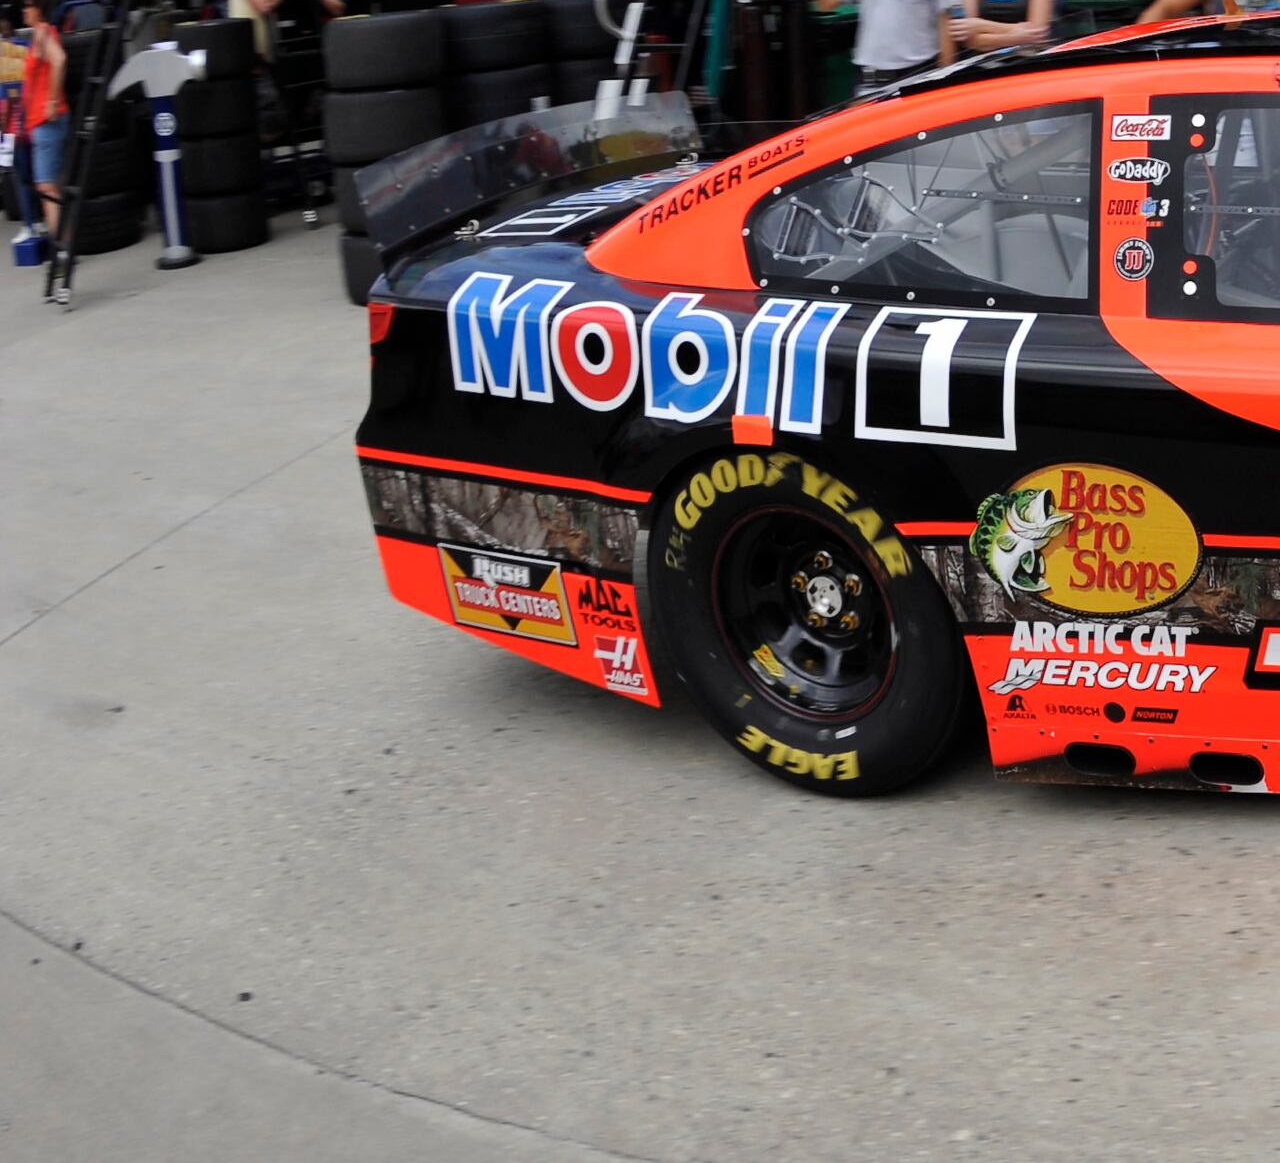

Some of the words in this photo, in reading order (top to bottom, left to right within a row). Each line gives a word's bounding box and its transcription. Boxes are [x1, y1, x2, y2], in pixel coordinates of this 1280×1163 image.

[637, 164, 743, 234] TRACKER
[748, 136, 805, 169] BOATS
[1107, 199, 1139, 216] CODE
[1158, 198, 1171, 218] 3
[447, 271, 852, 436] Mobil
[1058, 469, 1146, 515] Bass
[674, 451, 913, 579] GOODYEAR
[1064, 512, 1131, 551] Pro
[471, 555, 530, 587] RUSH
[1069, 550, 1177, 601] Shops
[454, 581, 498, 609] TRUCK
[500, 590, 562, 621] CENTERS
[578, 578, 634, 618] MAC
[582, 613, 637, 632] TOOLS
[1010, 621, 1129, 655] ARCTIC
[1131, 625, 1192, 658] CAT
[1003, 658, 1217, 693] MERCURY
[1058, 705, 1100, 717] BOSCH
[1136, 710, 1174, 720] NORTON
[736, 724, 861, 782] EAGLE
